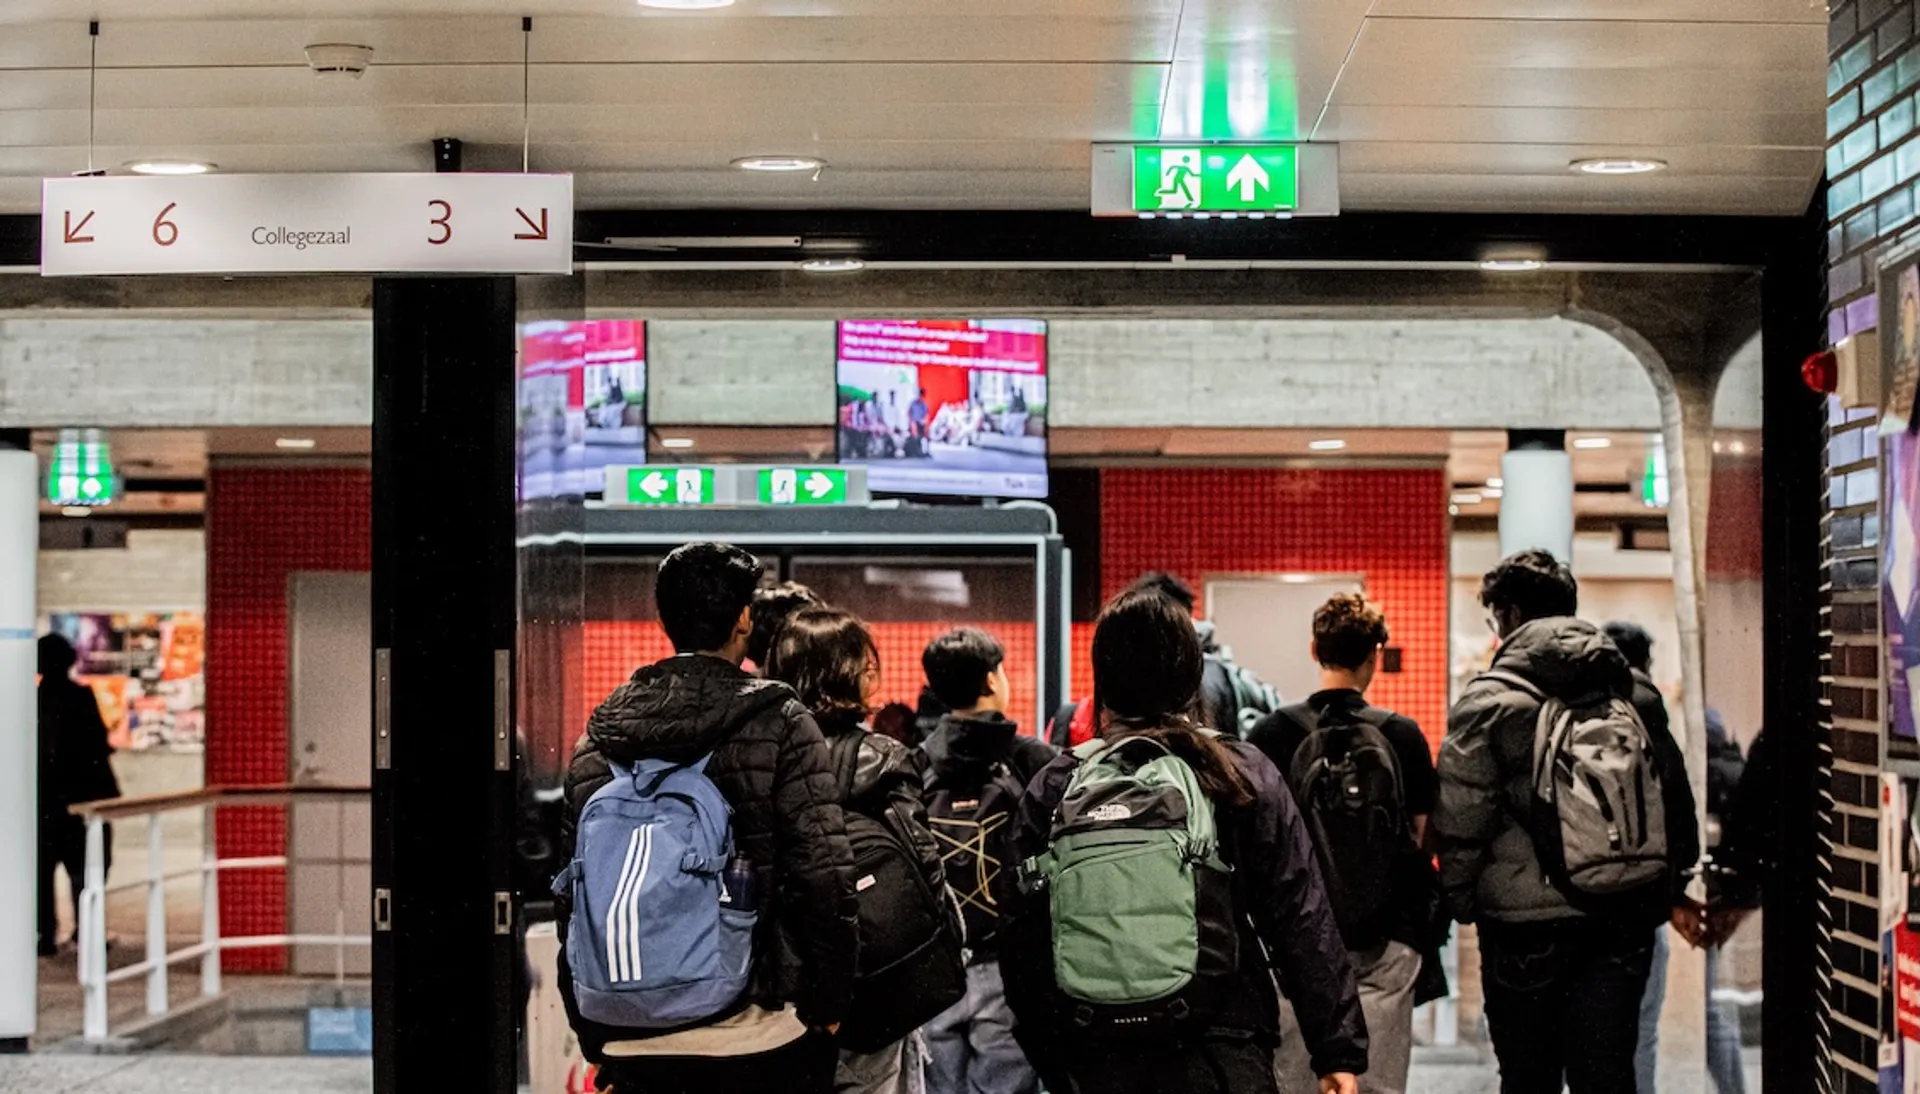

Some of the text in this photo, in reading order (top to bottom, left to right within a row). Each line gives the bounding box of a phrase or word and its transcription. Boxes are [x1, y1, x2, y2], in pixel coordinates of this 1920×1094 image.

[152, 199, 453, 250] 6 Collegezaal 3
